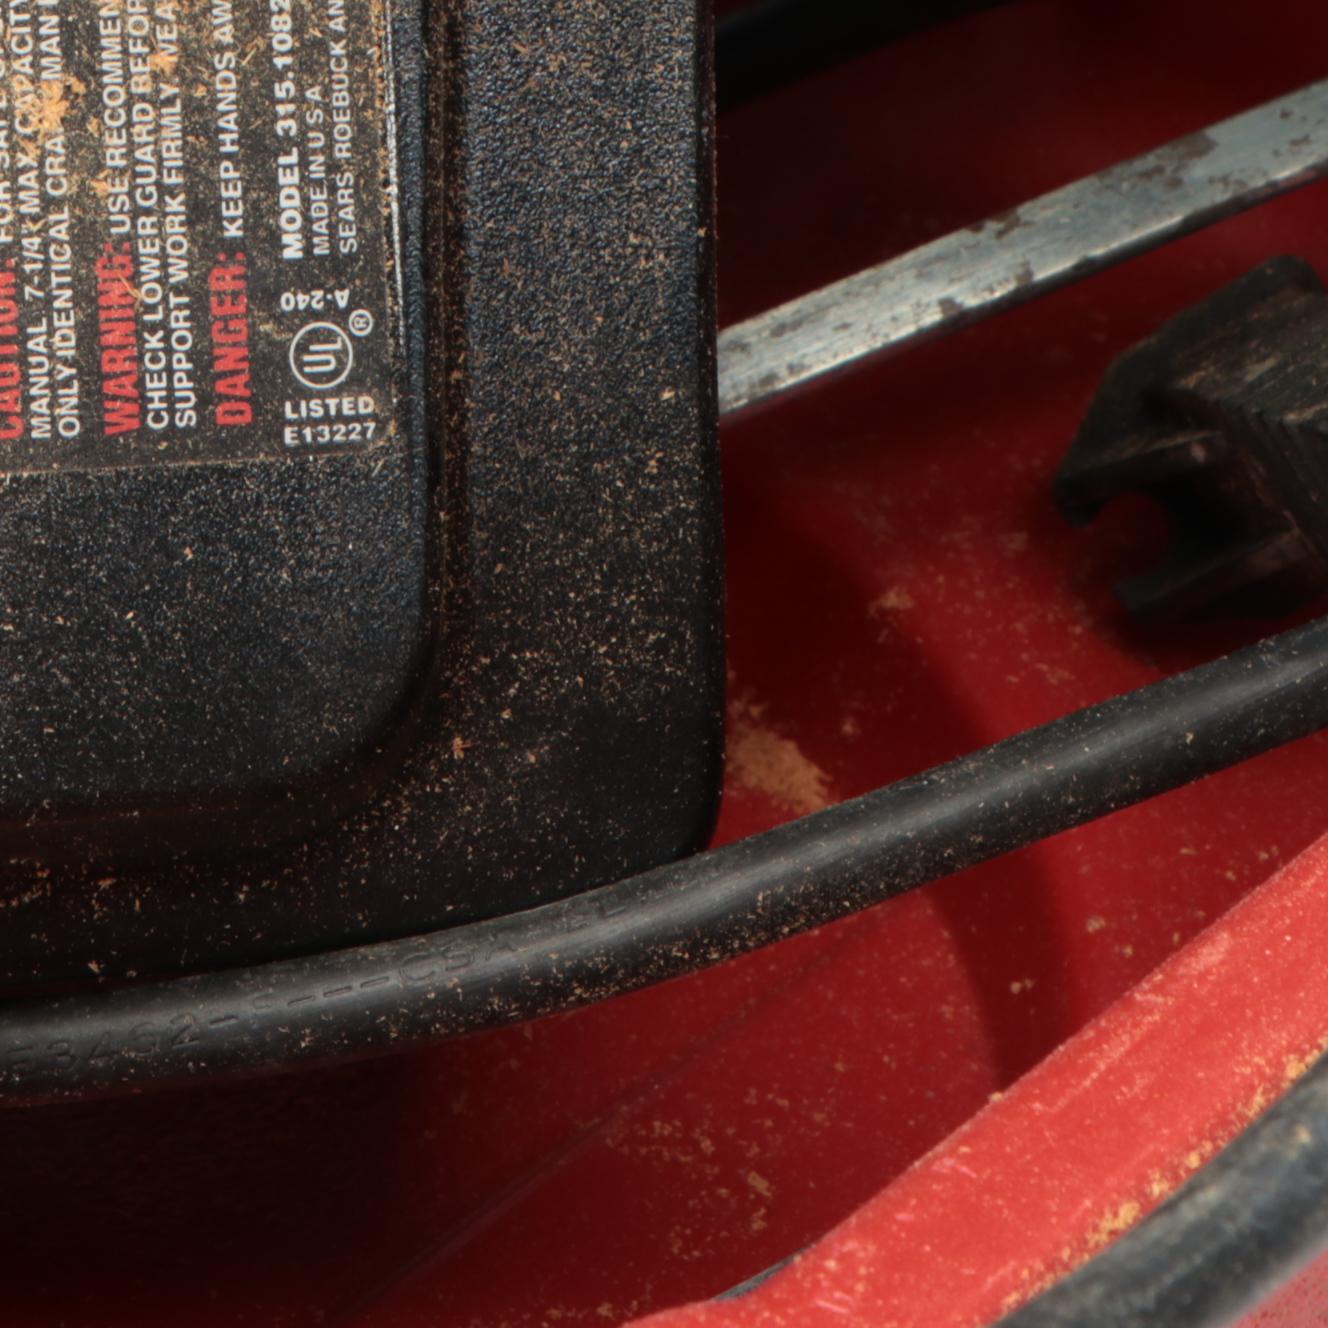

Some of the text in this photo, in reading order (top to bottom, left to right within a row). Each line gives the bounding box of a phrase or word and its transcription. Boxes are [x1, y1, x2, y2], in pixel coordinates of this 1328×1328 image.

[38, 14, 67, 196] CRAMAN
[214, 51, 239, 152] HANDS
[329, 38, 352, 158] ROEBUCK
[107, 176, 131, 233] USE
[131, 102, 157, 207] GUARD
[220, 159, 244, 237] KEEP
[277, 147, 304, 259] MODEL
[308, 155, 326, 176] IN
[137, 215, 163, 321] LOWER
[164, 192, 190, 282] WORK
[310, 185, 330, 255] MADE
[47, 206, 76, 355] IDENTICAL
[97, 240, 140, 435] WARNING:
[143, 330, 169, 429] CHECK
[169, 291, 196, 428] SUPPORT
[210, 251, 253, 425] DANGER:
[55, 361, 80, 438] ONLY
[284, 396, 375, 419] LISTED
[284, 422, 376, 446] E13227
